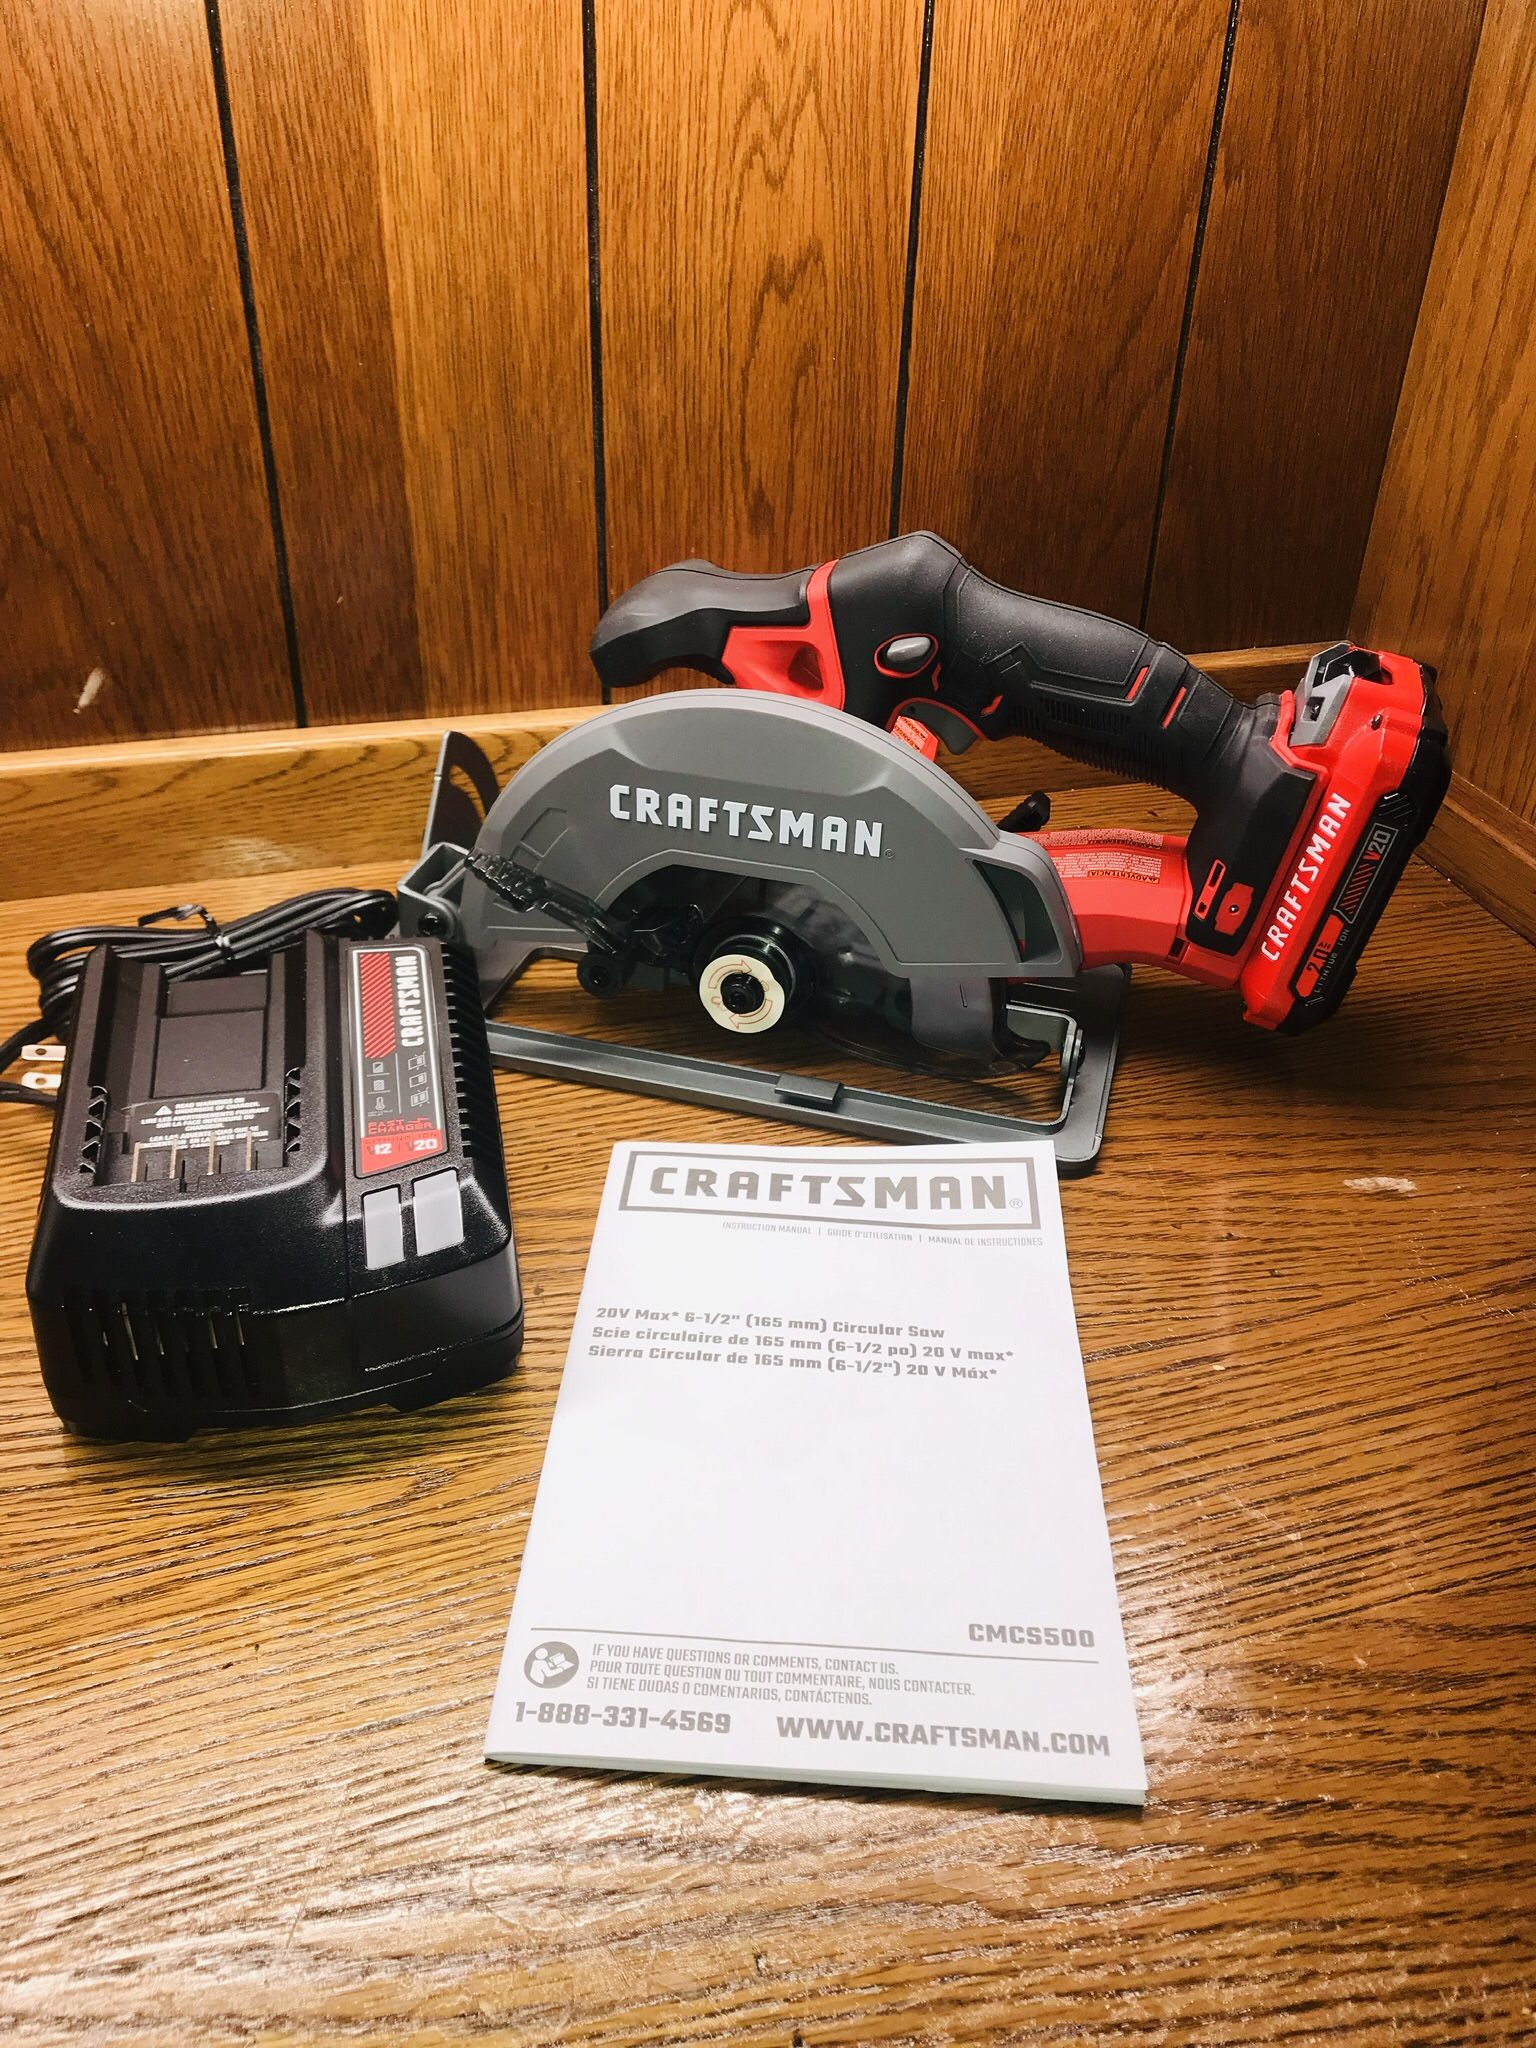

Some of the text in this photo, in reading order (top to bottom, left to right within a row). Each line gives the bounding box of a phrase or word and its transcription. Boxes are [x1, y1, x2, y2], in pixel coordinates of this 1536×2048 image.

[609, 784, 884, 858] CRAFTSMAN
[1363, 829, 1392, 862] V20
[1261, 792, 1351, 962] CRAFTSMAN
[394, 955, 425, 1048] CRAFTSMAN
[649, 1166, 1008, 1211] CRAFTSMAN
[722, 1221, 777, 1233] INSTRUCTION
[778, 1224, 812, 1235] MANUAL
[827, 1228, 853, 1238] GUIDE
[928, 1235, 962, 1246] MANUAL
[964, 1238, 975, 1247] DE
[595, 1307, 631, 1320] 20V
[745, 1313, 783, 1328] (165
[788, 1318, 828, 1334] mm)
[832, 1321, 904, 1337] Circular
[907, 1325, 946, 1339] Saw
[592, 1326, 632, 1340] Scie
[635, 1328, 723, 1345] circulaire
[727, 1334, 750, 1346] de
[754, 1334, 785, 1348] 165
[789, 1338, 822, 1351] mm
[827, 1338, 882, 1355] (6-1/2
[887, 1342, 918, 1359] po)
[922, 1345, 946, 1359] 20
[949, 1347, 963, 1360] V
[587, 1344, 644, 1359] Sierra
[648, 1347, 722, 1363] Circular
[726, 1352, 749, 1365] de
[753, 1352, 784, 1367] 165
[789, 1357, 822, 1370] mm
[906, 1363, 929, 1376] 20
[934, 1365, 947, 1378] V
[968, 1622, 1096, 1648] CMCS500
[592, 1643, 900, 1675] IF YOU HAVE QUESTIONS OR COMMENTS, CONTACT US.
[586, 1676, 600, 1690] SI
[602, 1677, 637, 1692] TIENE
[638, 1679, 680, 1694] DUDAS
[693, 1682, 782, 1703] COMENTARIOS,
[784, 1688, 873, 1706] CONTÁCTENOS.
[589, 1659, 976, 1697] POUR TOUTE QUESTION OU TOUT COMMENTAIRE, NOUS CONTACTER.
[515, 1700, 1112, 1757] 1-888-331-4569 WWW.CRAFTSMAN.COM
